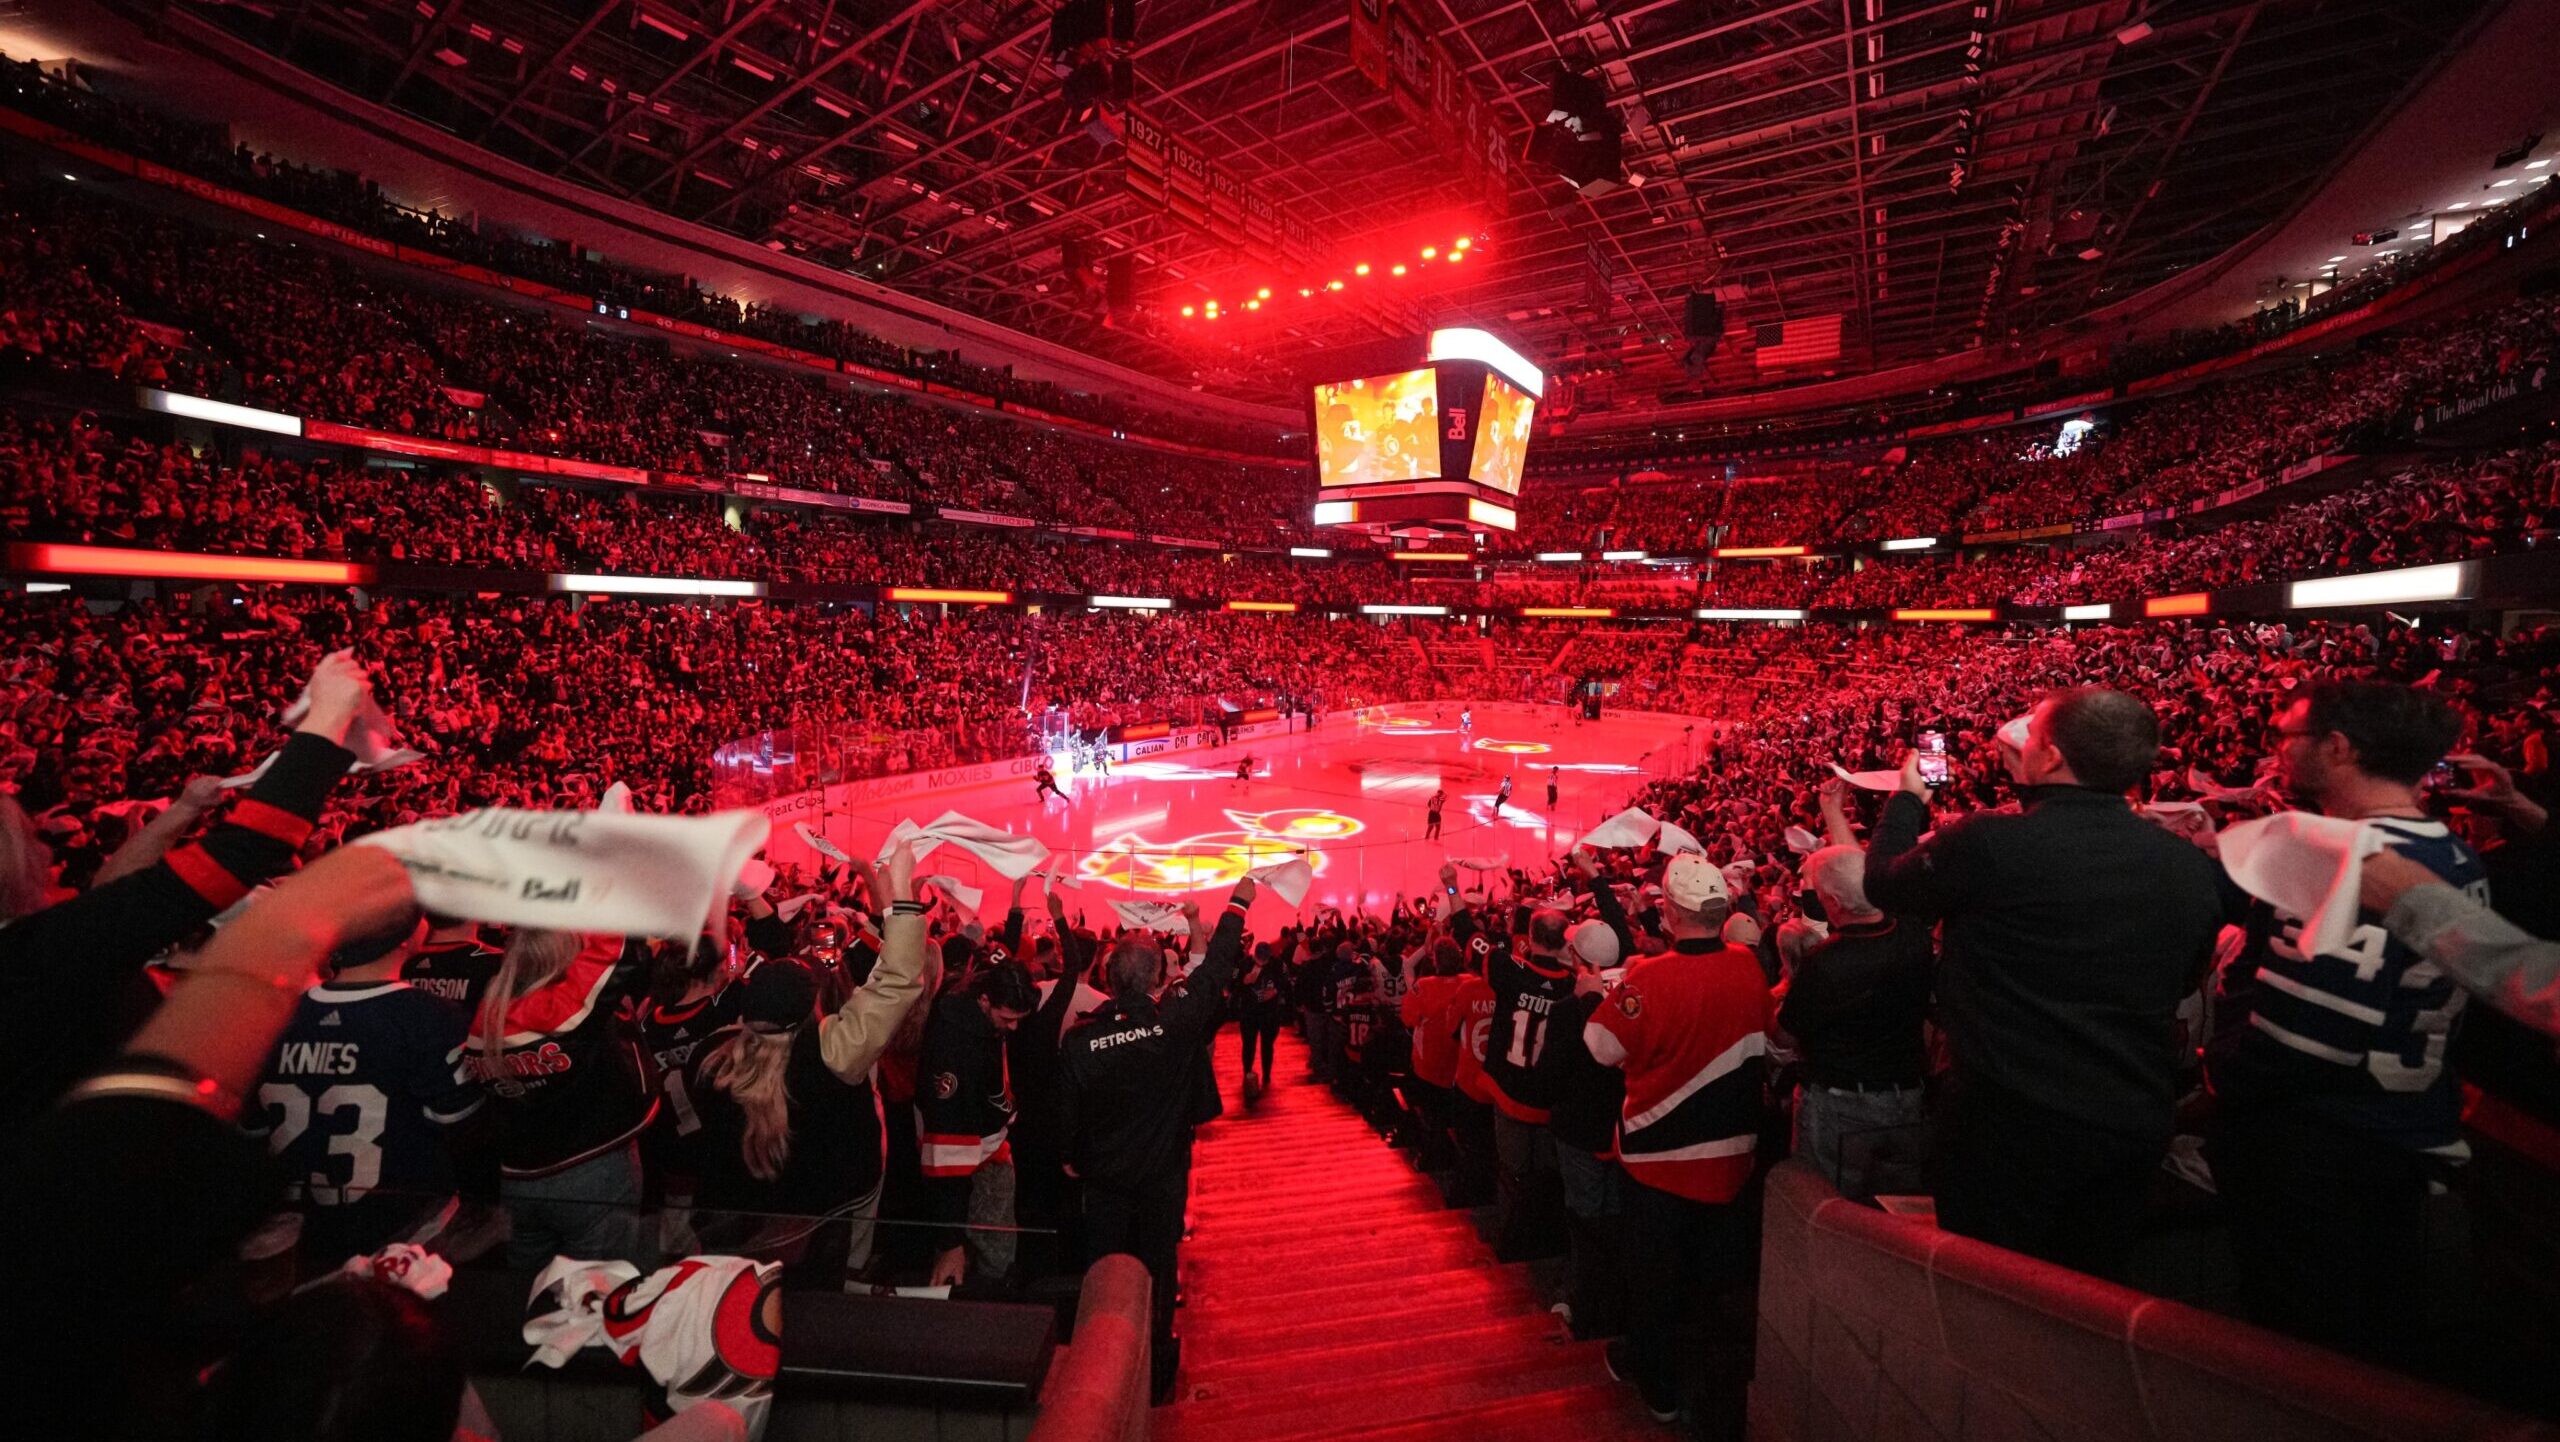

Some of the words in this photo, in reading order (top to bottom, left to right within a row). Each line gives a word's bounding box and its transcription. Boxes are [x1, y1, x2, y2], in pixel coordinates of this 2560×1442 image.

[1129, 116, 1162, 151] 1927
[1172, 145, 1203, 178] 1923
[1488, 126, 1508, 175] 25
[1213, 171, 1239, 200] 1921
[1247, 194, 1273, 221] 1920
[2436, 404, 2454, 424] The
[2457, 387, 2490, 416] Royal
[2491, 377, 2517, 403] Oak
[1448, 408, 1466, 440] Bell
[1135, 743, 1164, 756] CALIAN
[1174, 735, 1188, 750] CAT
[843, 778, 914, 801] Molson
[928, 766, 993, 789] MOXIES
[523, 878, 581, 903] Bell
[1471, 937, 1490, 955] 8
[278, 1042, 360, 1075] KNIES
[258, 1082, 389, 1206] 23
